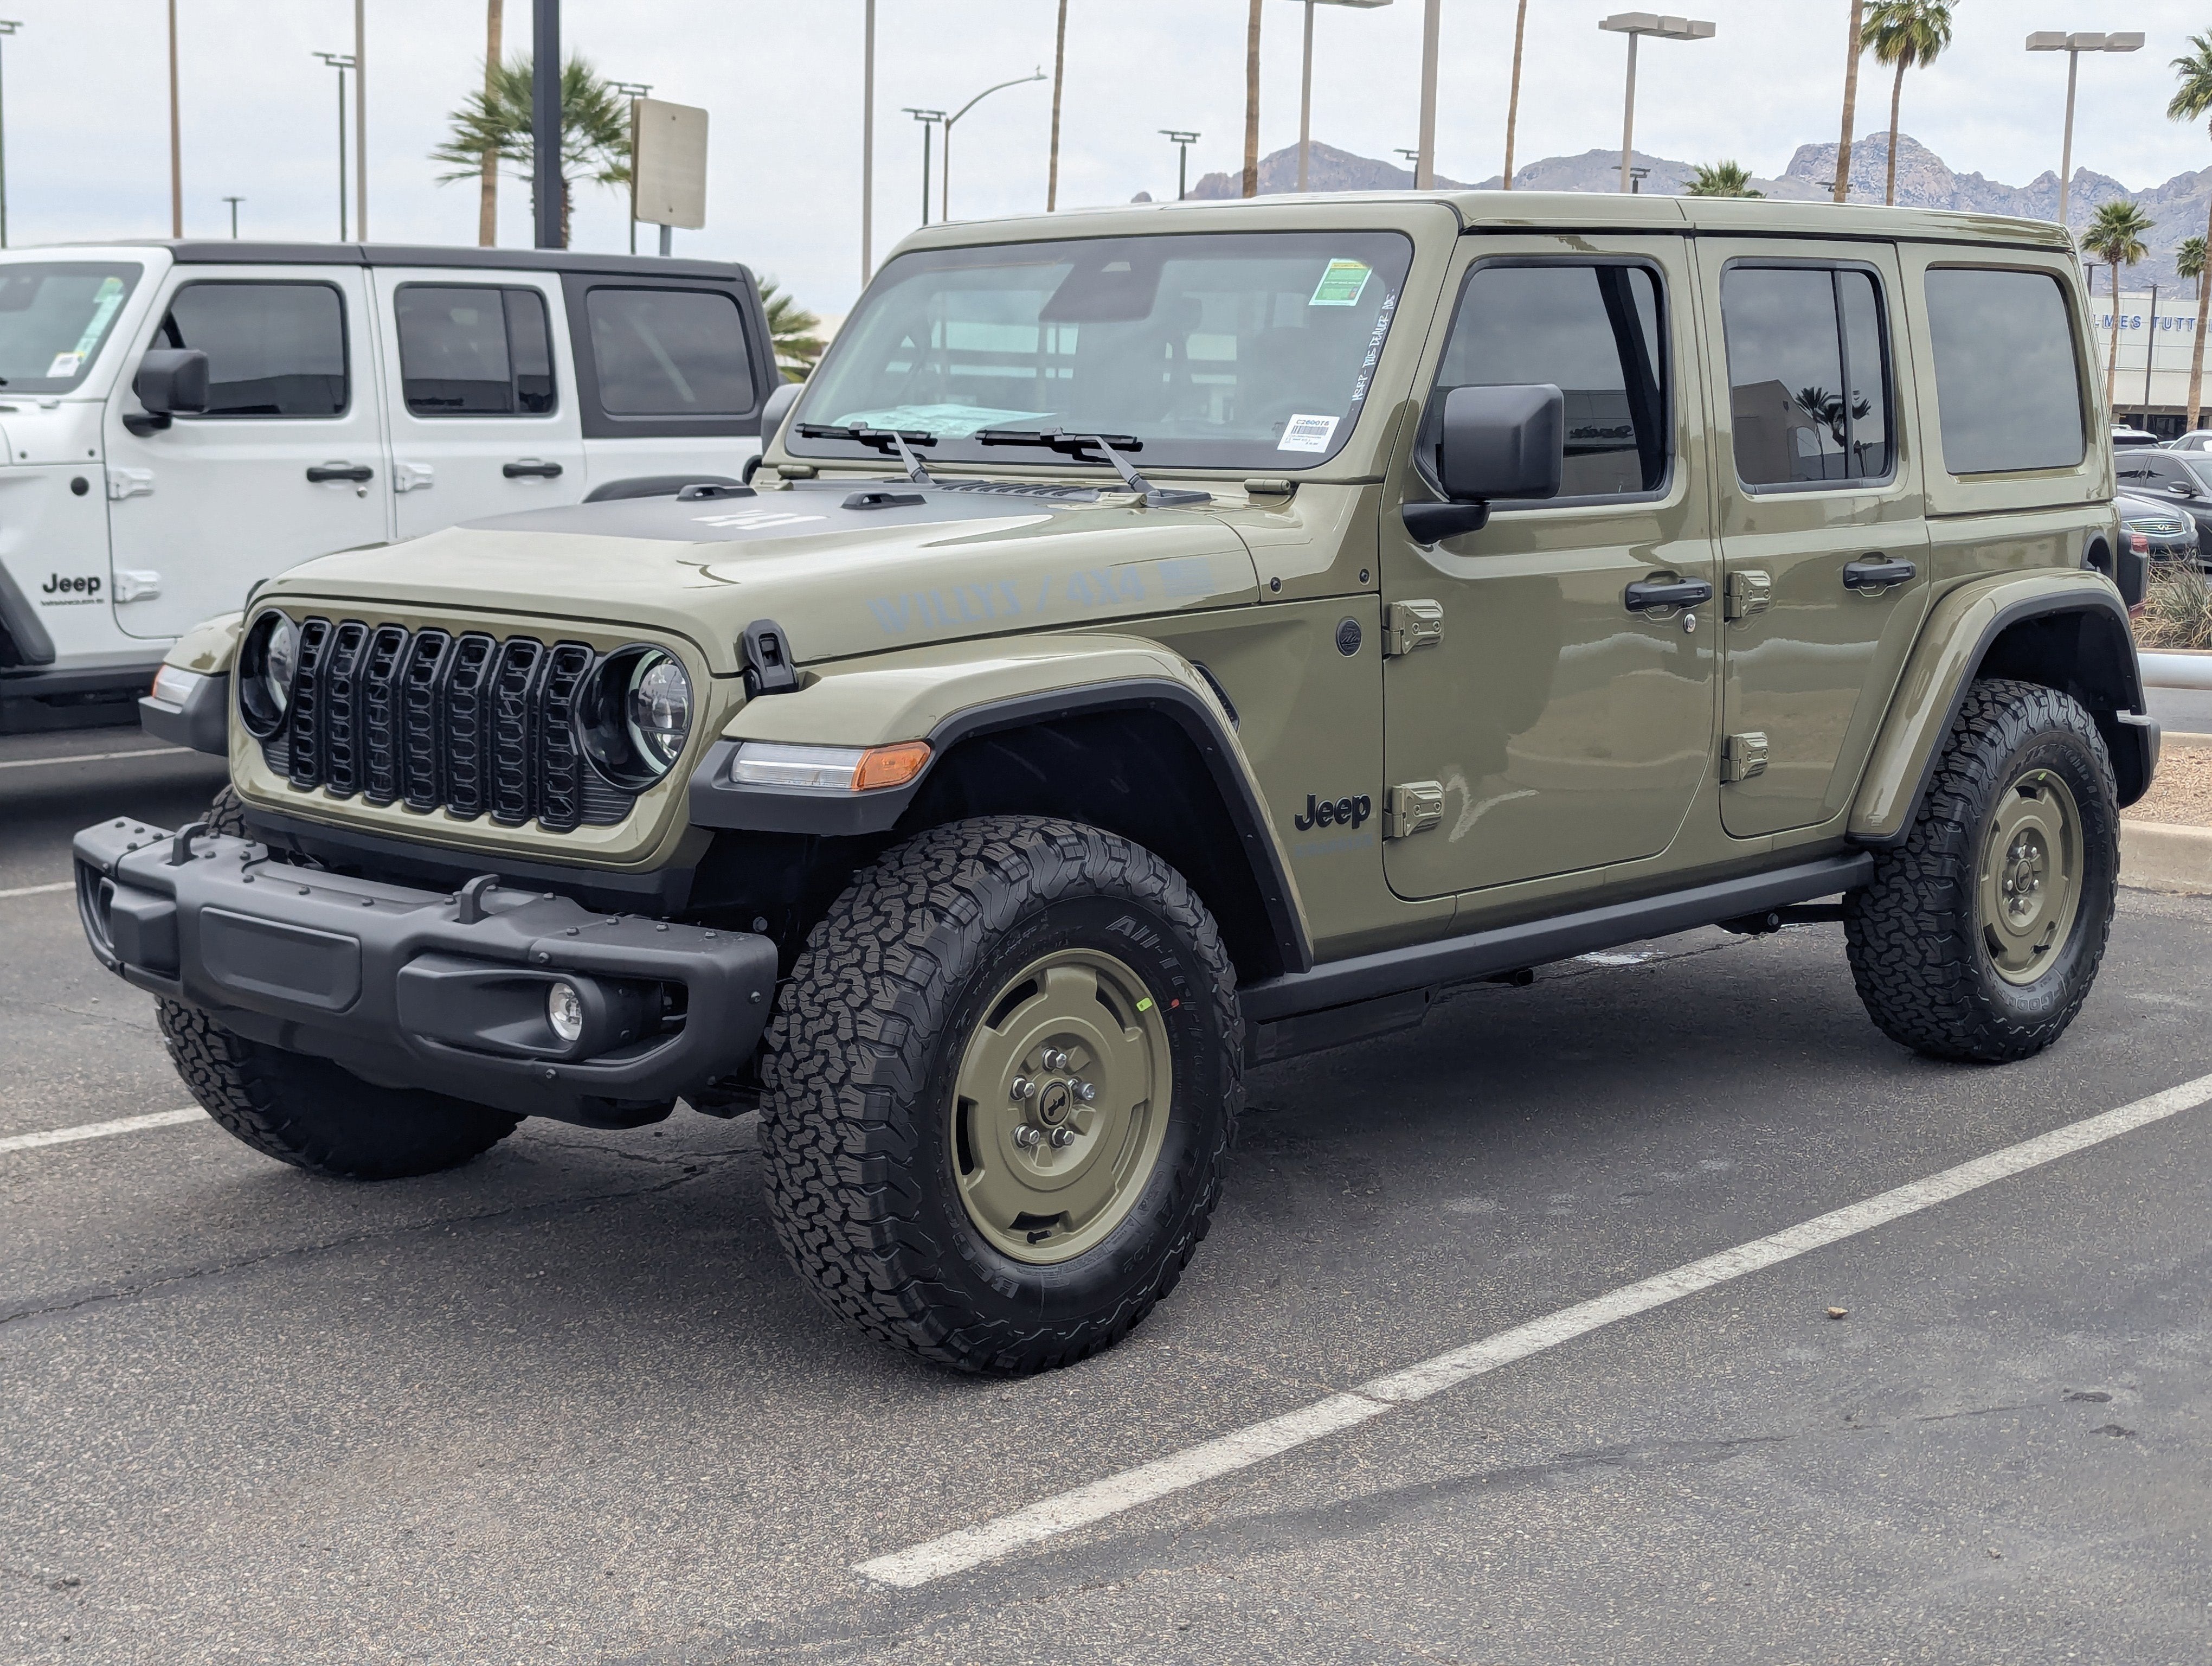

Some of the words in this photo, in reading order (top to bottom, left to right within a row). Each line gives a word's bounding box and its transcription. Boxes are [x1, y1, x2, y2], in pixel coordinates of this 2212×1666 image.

[2153, 316, 2212, 331] TUTT
[42, 573, 101, 596] Jeep
[867, 580, 1020, 634] WILLYS
[1295, 793, 1371, 831] Jeep
